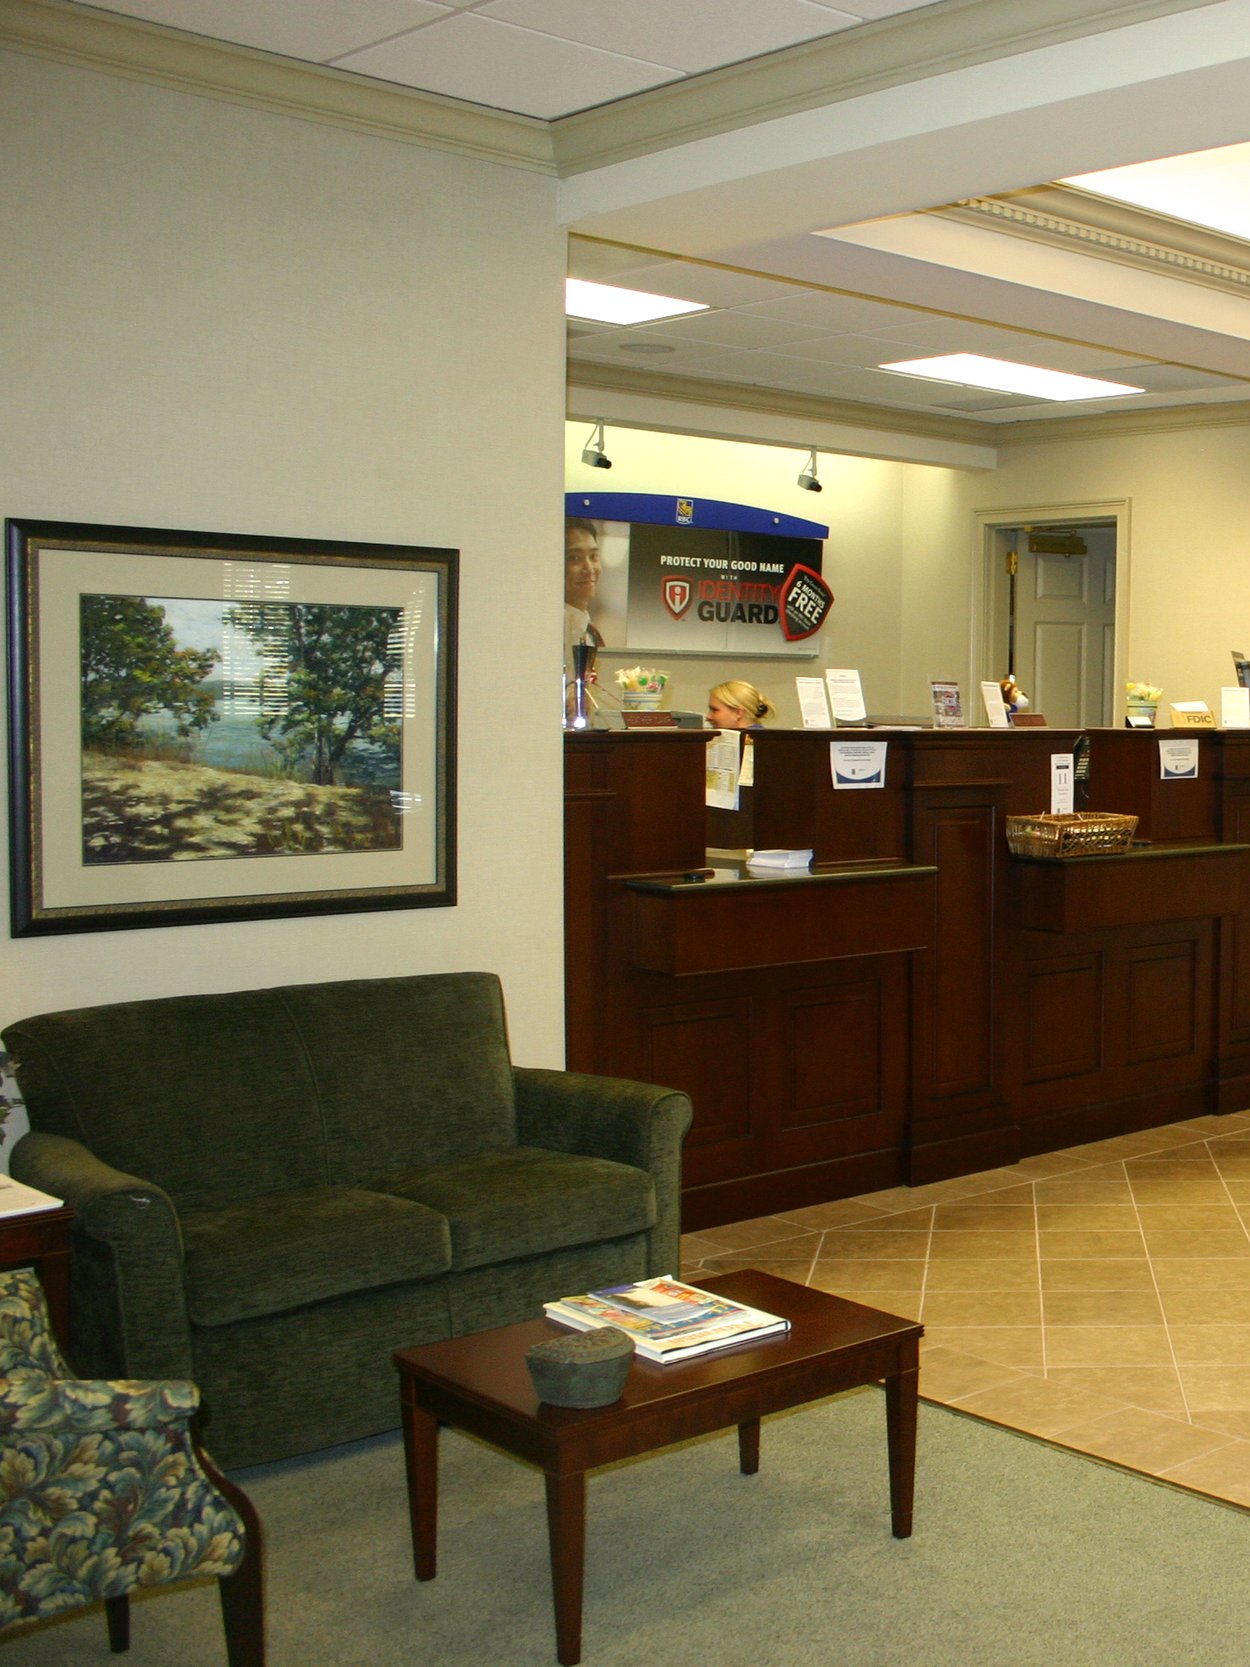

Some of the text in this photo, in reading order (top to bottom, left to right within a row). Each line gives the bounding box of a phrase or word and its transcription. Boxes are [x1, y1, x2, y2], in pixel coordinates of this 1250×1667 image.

[660, 555, 784, 573] PROTECT YOUR GOOD NAME
[698, 580, 781, 603] IDENTITY
[802, 584, 825, 608] MONTHS
[697, 601, 779, 625] GUARD
[788, 587, 822, 624] FREE
[1186, 715, 1212, 724] FDIC
